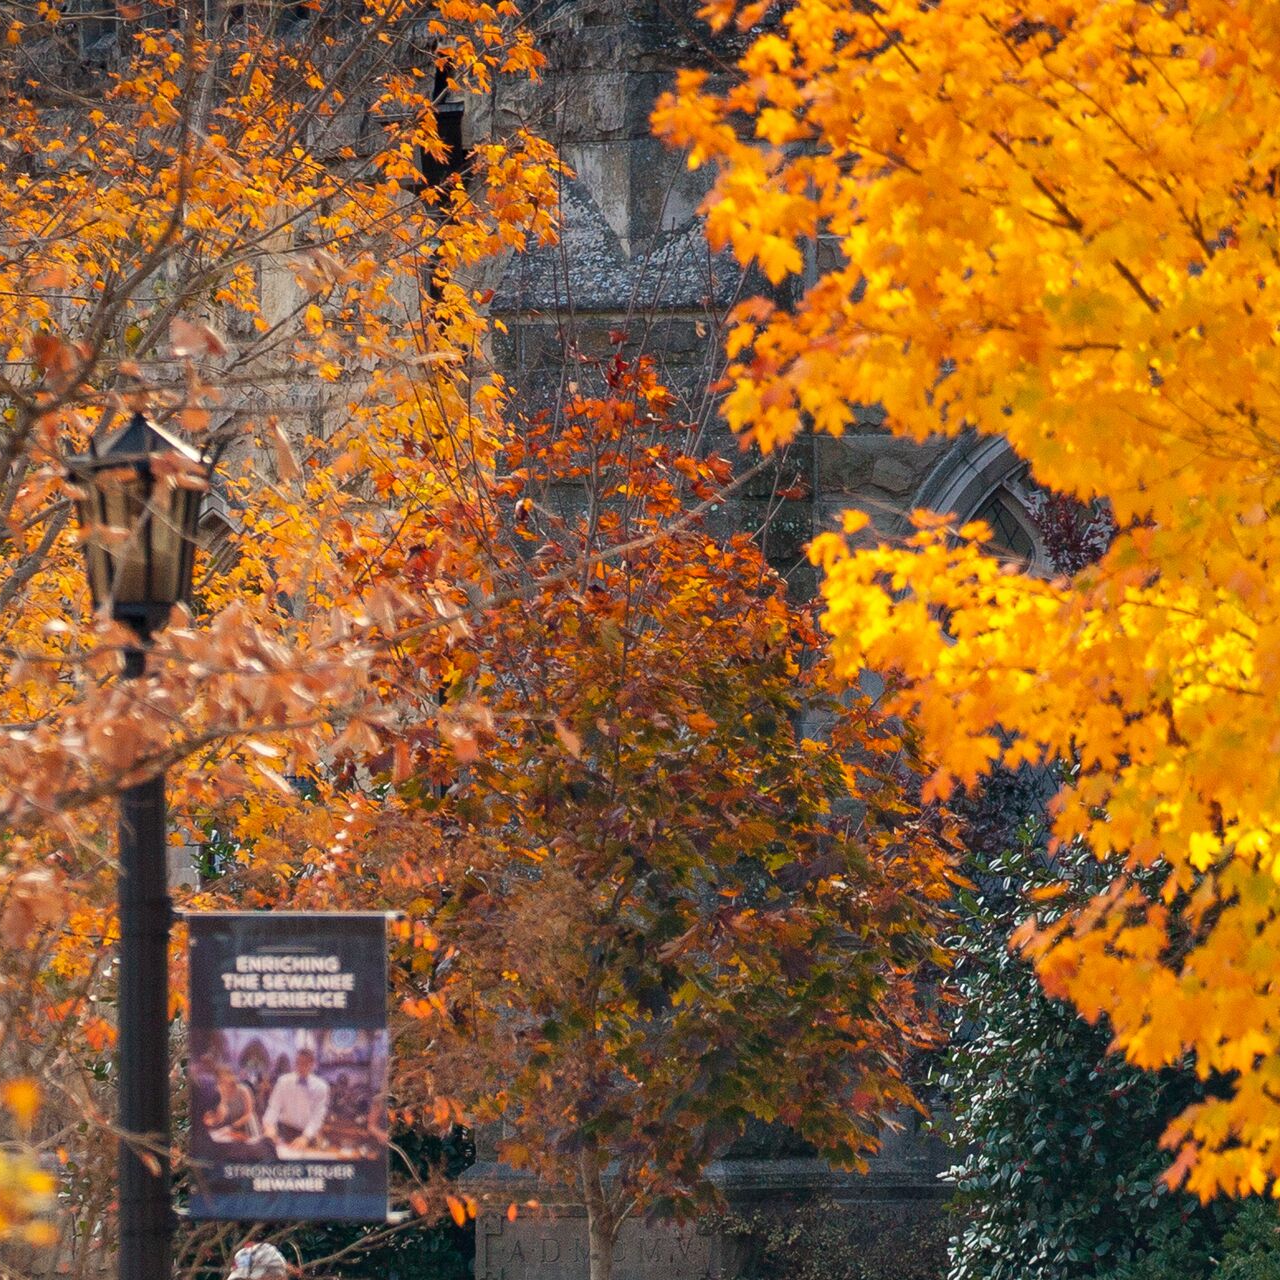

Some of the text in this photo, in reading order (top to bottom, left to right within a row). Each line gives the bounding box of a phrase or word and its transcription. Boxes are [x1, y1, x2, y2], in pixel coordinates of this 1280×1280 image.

[235, 955, 340, 973] ENRICHING
[221, 973, 355, 991] THE SEWANEE
[229, 991, 347, 1009] EXPERIENCE
[253, 1178, 327, 1193] SEWANEE
